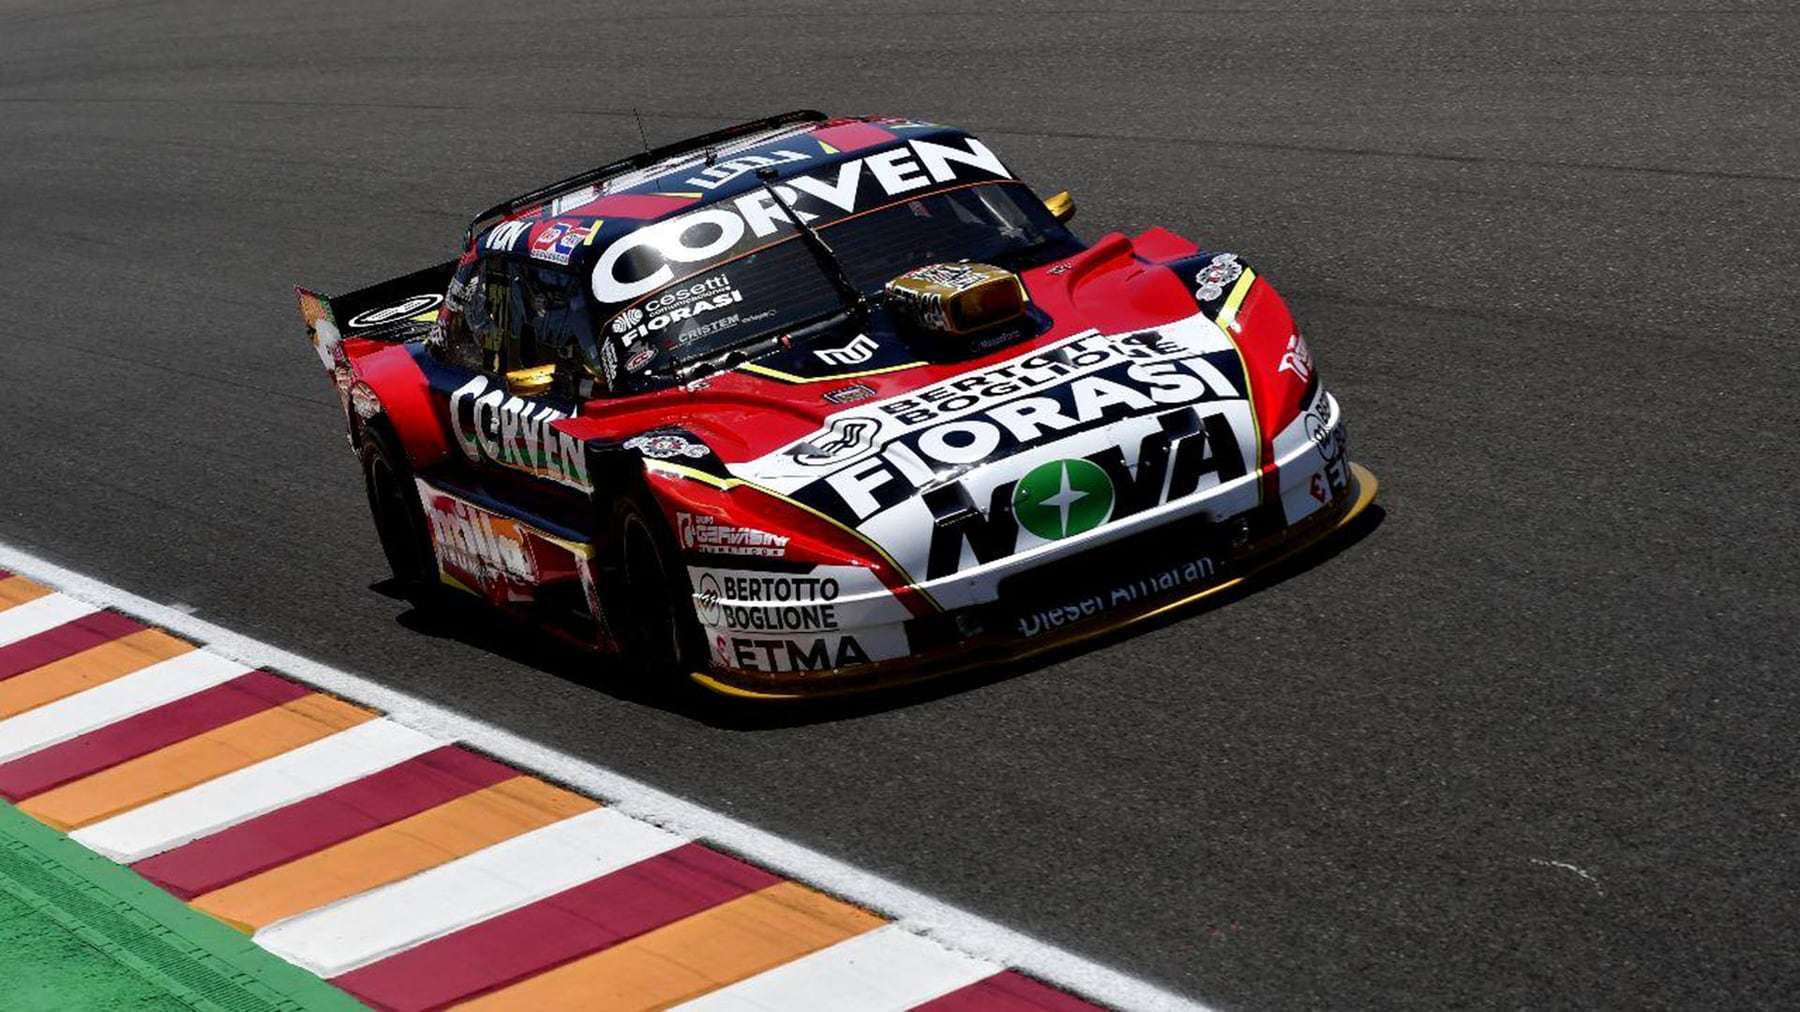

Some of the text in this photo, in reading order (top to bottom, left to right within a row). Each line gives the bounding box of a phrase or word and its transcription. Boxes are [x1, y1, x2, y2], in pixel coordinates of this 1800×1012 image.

[592, 137, 1013, 303] CORVEN
[645, 273, 730, 312] cesetti
[621, 289, 743, 347] FIORASI
[678, 313, 740, 343] CRISTEM
[450, 375, 588, 484] CORVEN
[828, 357, 1239, 521] FIORASI
[927, 408, 1247, 581] NOVA
[724, 576, 840, 602] BERTOTTO
[722, 604, 838, 630] BOGLIONE
[731, 635, 874, 672] ETMA
